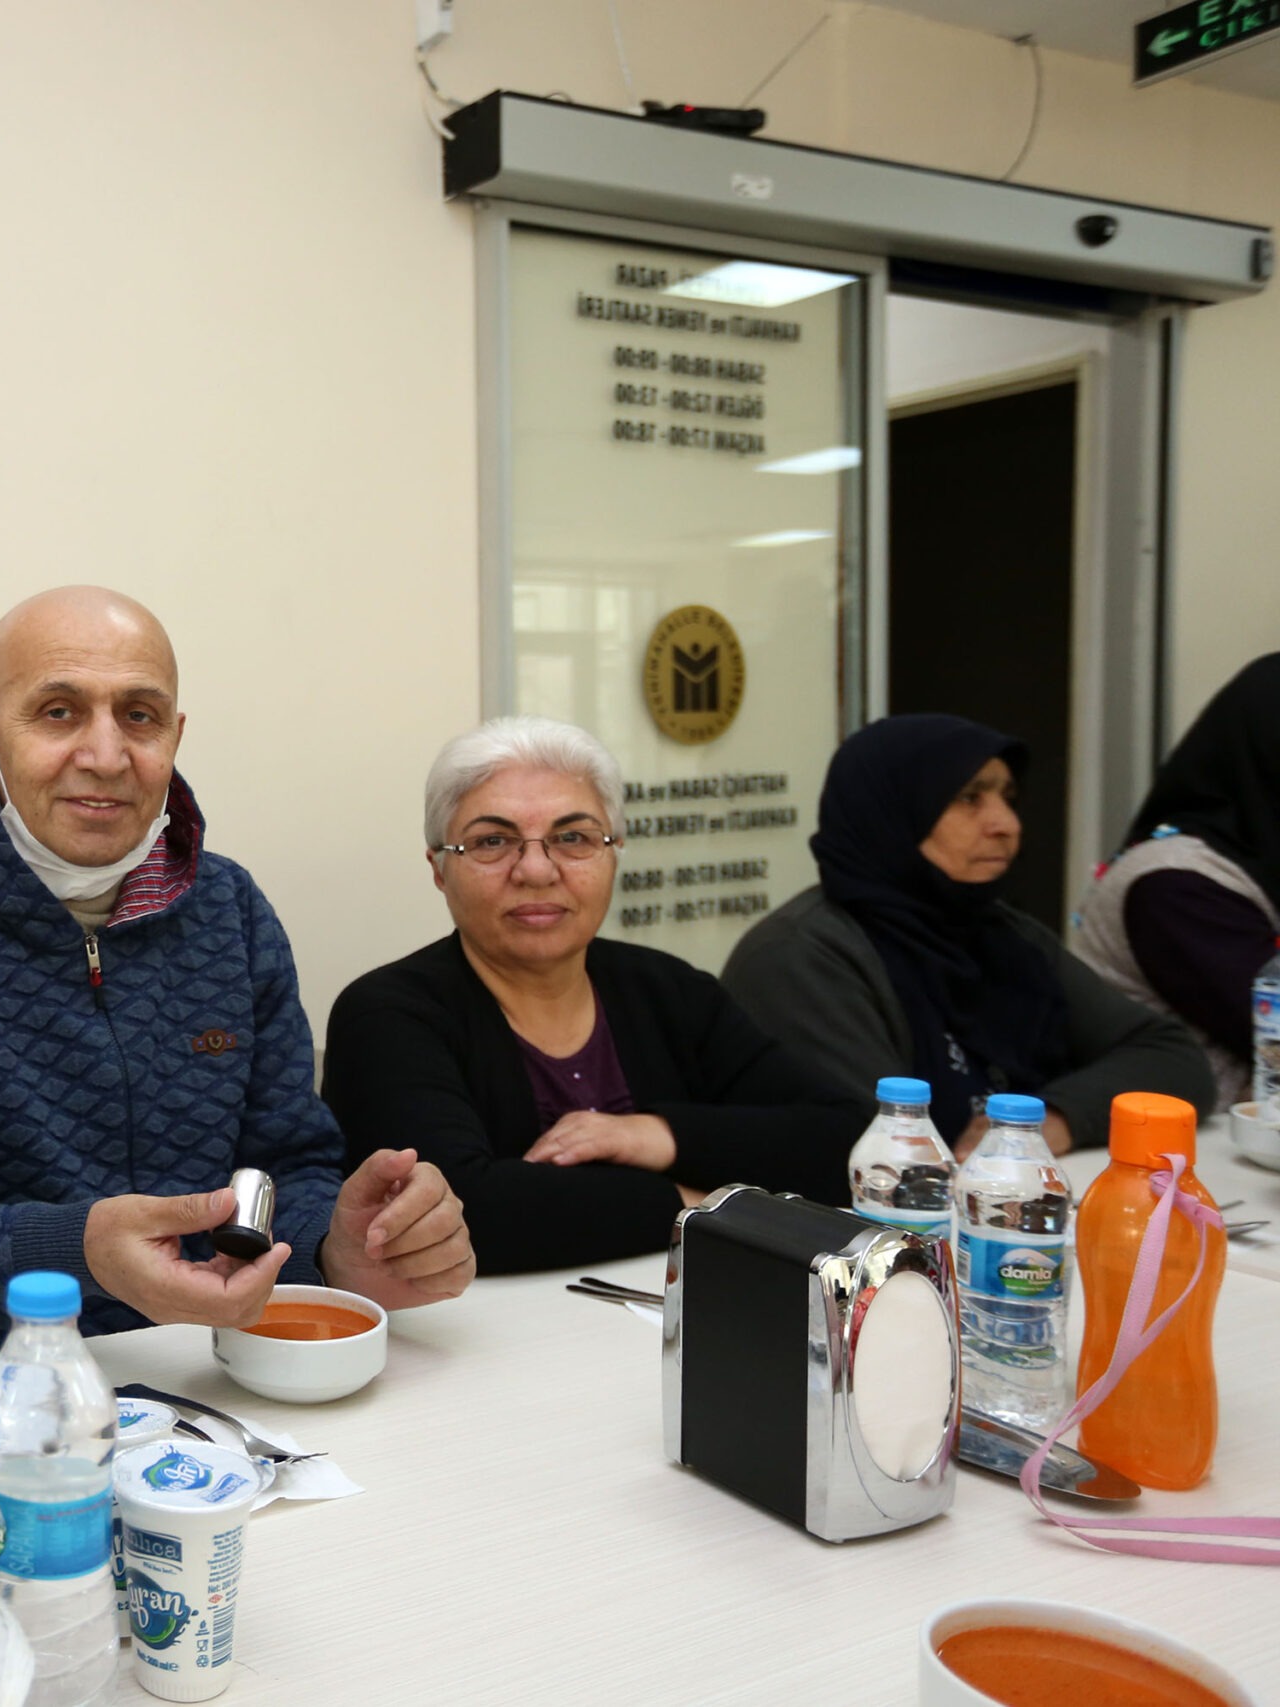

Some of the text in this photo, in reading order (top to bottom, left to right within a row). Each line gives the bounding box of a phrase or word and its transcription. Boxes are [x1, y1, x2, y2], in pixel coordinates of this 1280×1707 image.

[1198, 0, 1256, 27] EX
[1000, 1265, 1051, 1280] damla
[128, 1531, 180, 1559] nlıca
[129, 1587, 184, 1628] yran
